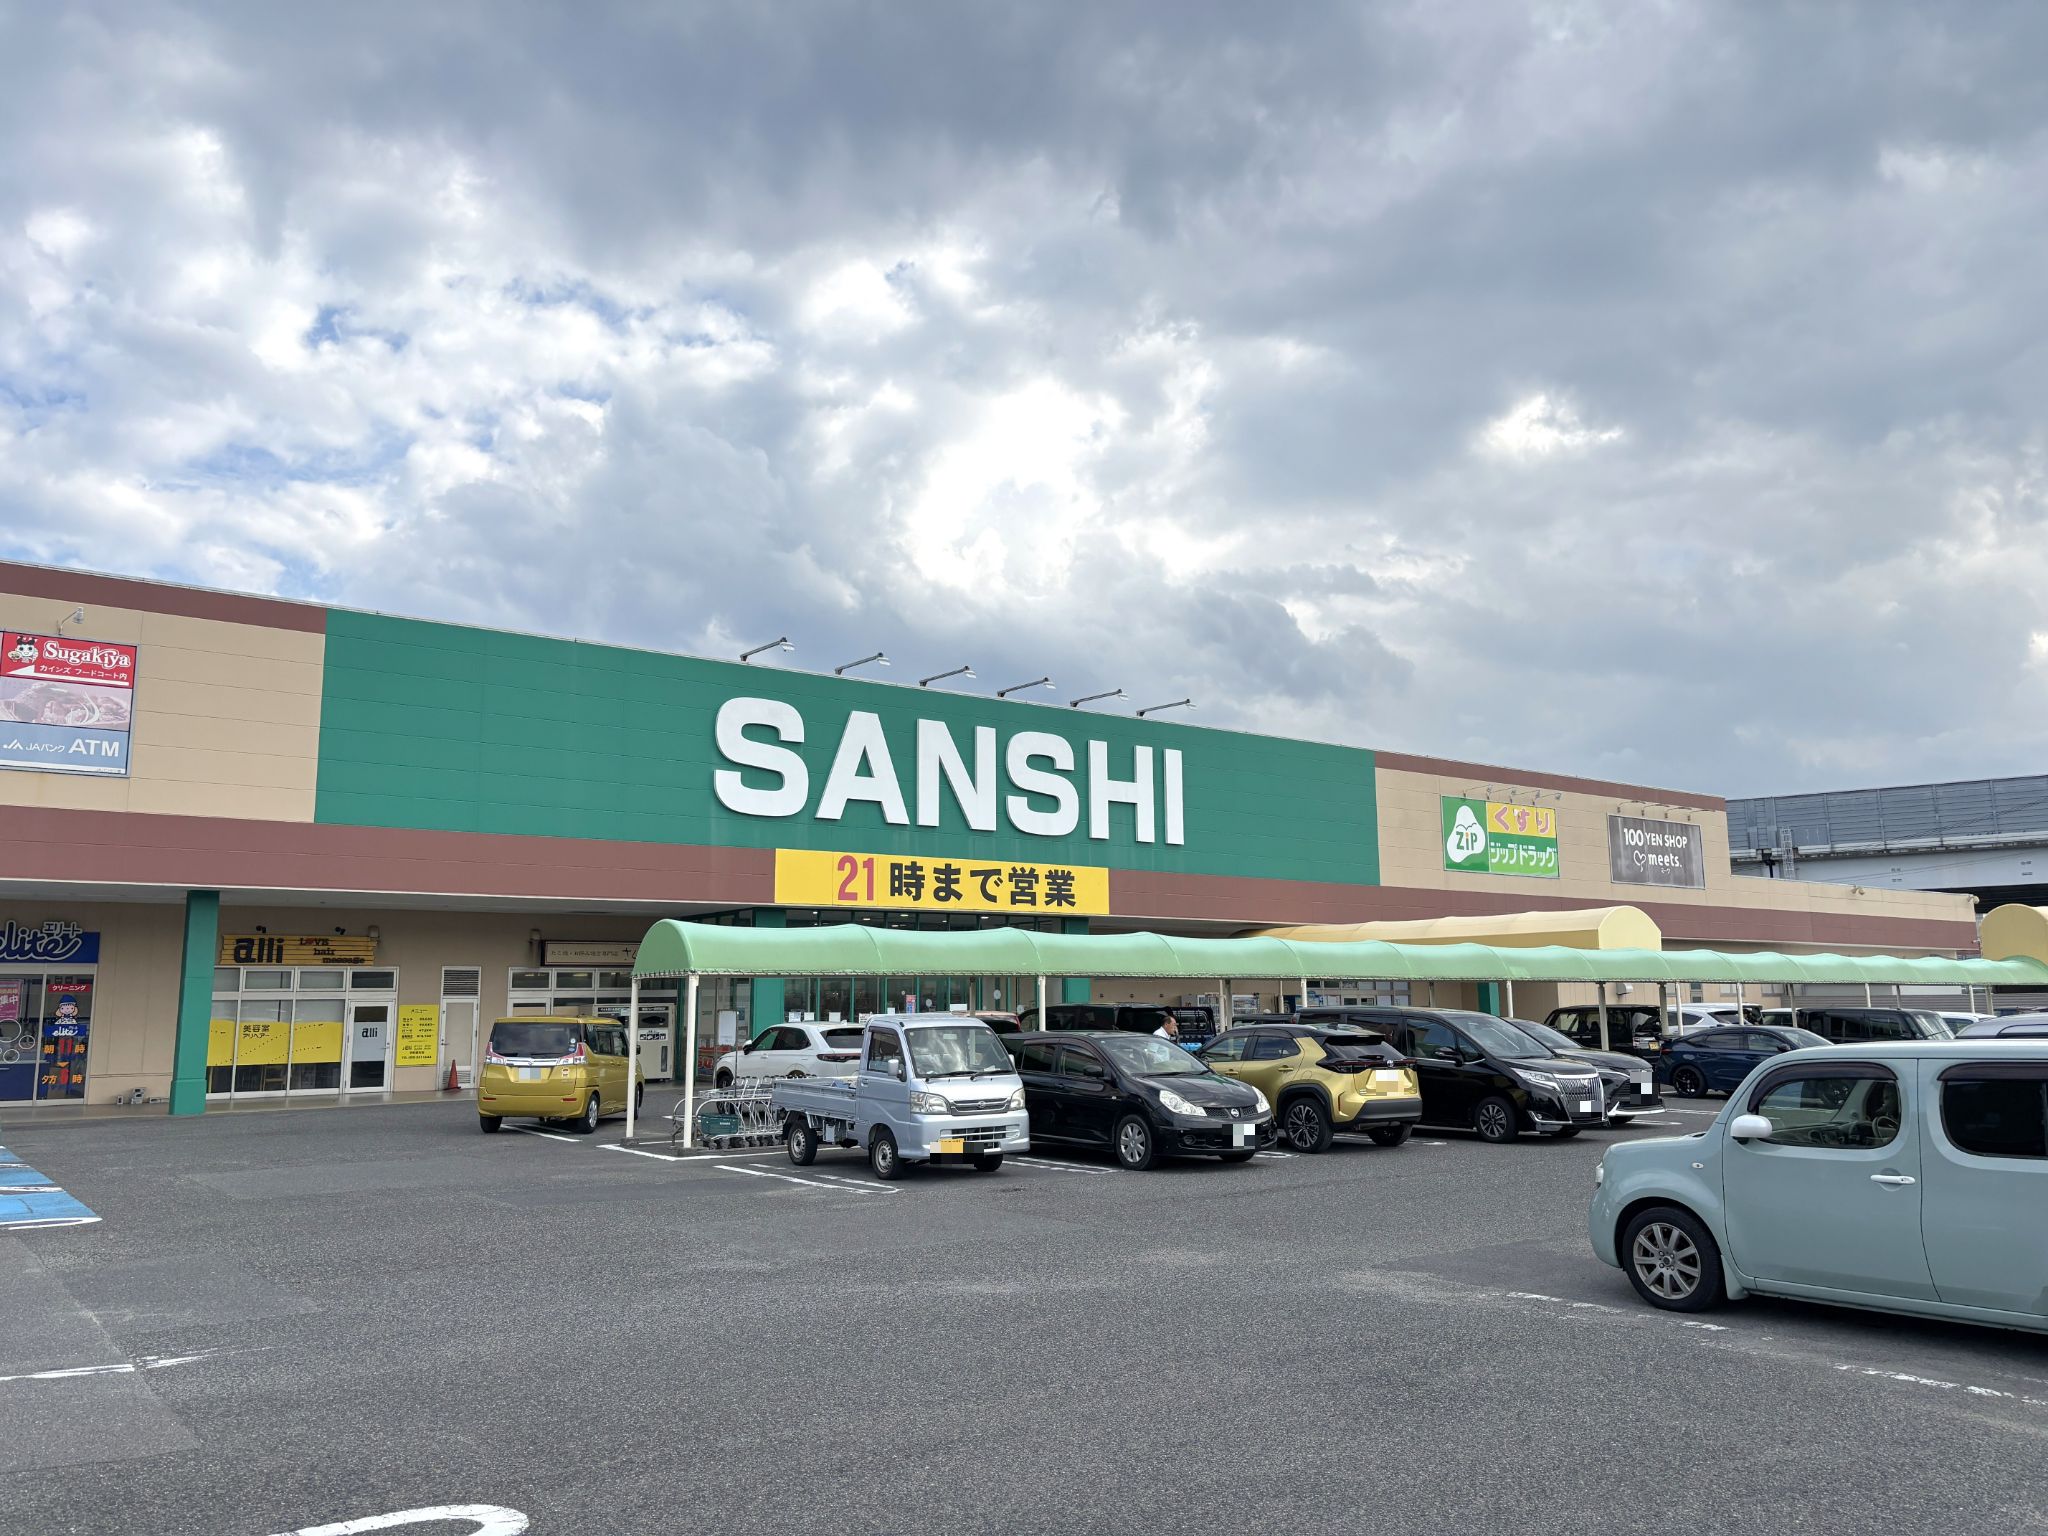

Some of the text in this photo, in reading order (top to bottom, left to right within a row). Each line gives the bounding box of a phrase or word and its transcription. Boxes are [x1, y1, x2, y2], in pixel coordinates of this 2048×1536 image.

[44, 641, 130, 668] Sugakiya
[40, 665, 127, 679] カインズ フードコート内
[26, 743, 65, 752] JAバンク
[68, 739, 120, 757] ATM
[713, 697, 1185, 846] SANSHI
[1495, 807, 1549, 833] くすり
[1624, 828, 1688, 848] 100 YEN SHOP
[1490, 842, 1557, 867] ジップドラッグ
[1648, 853, 1682, 867] meets.
[837, 855, 1077, 907] 21時まで営業
[43, 922, 82, 938] エリート
[234, 938, 284, 963] alli
[52, 1026, 78, 1036] elite
[243, 1024, 270, 1032] 美容室
[362, 1027, 378, 1037] alli
